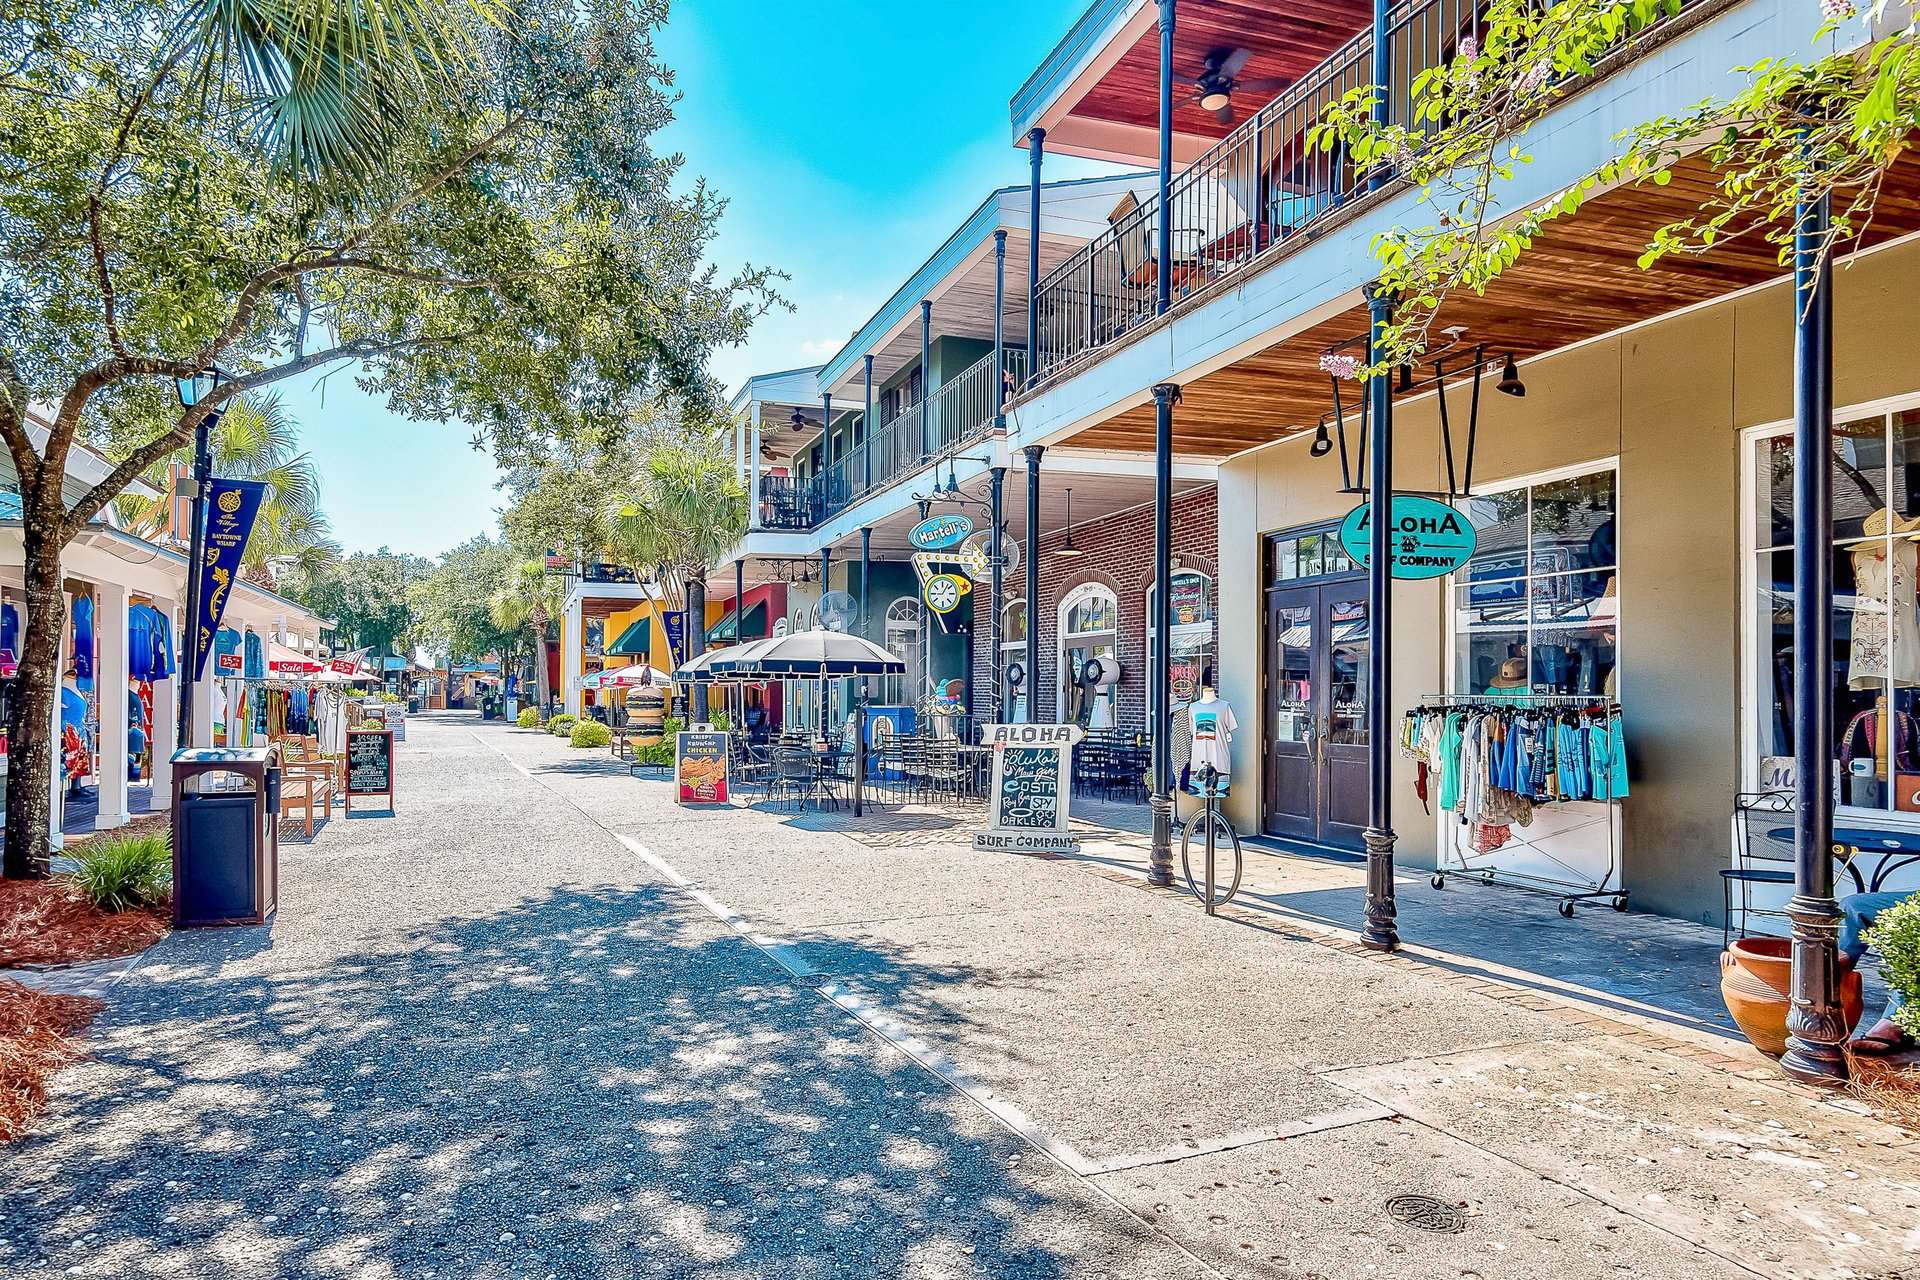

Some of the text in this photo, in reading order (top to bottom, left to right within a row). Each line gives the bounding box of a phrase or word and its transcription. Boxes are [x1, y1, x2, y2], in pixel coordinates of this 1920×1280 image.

[919, 521, 968, 544] Hartell's
[1400, 555, 1456, 567] COMPANY
[281, 663, 302, 672] Sale
[1281, 700, 1306, 708] ALOHA
[1335, 700, 1364, 709] ALOHA
[995, 727, 1071, 742] ALOHA
[1003, 780, 1057, 794] COSTA
[1002, 796, 1017, 809] Ray
[1031, 797, 1052, 809] SPY
[1001, 815, 1044, 826] OAKLEY
[977, 834, 1073, 848] SURF COMPANY
